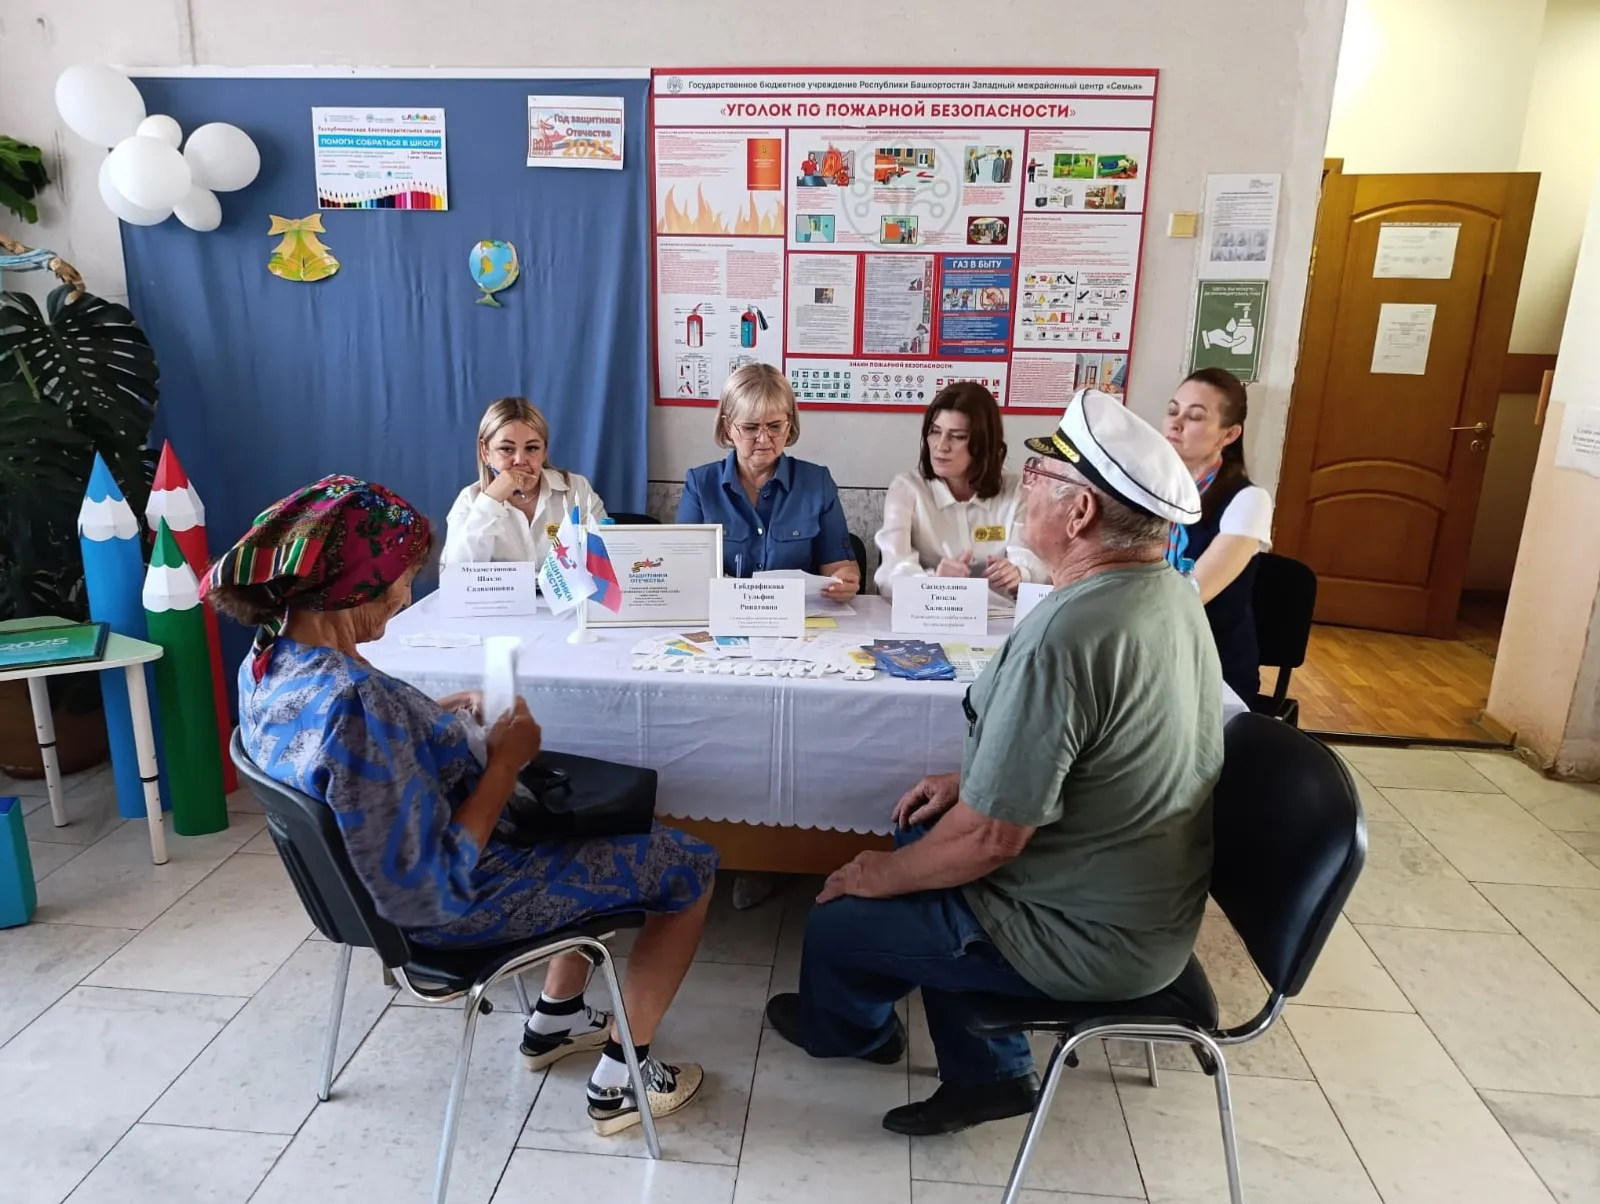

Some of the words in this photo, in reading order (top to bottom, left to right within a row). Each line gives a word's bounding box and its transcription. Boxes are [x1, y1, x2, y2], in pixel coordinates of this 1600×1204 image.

[688, 81, 758, 91] Государственное
[759, 80, 806, 91] бюджетное
[808, 81, 858, 91] учреждение
[859, 80, 909, 91] Республики
[910, 80, 970, 91] Башкортостан
[972, 81, 1015, 91] Западный
[1017, 81, 1077, 91] межрайонный
[1079, 82, 1104, 92] центр
[1106, 82, 1143, 92] «Семья»
[720, 103, 792, 117] «УГОЛОК
[797, 103, 821, 117] ПО
[825, 101, 926, 118] ПОЖАРНОЙ
[930, 103, 1076, 118] БЕЗОПАСНОСТИ»
[554, 114, 570, 125] Год
[571, 116, 621, 126] защитника
[566, 127, 612, 138] Отечества
[321, 138, 354, 146] ПОМОГИ
[355, 138, 401, 147] СОБРАТЬСЯ
[402, 139, 409, 147] В
[410, 139, 439, 148] ШКОЛУ
[562, 139, 615, 158] 2025
[952, 260, 969, 269] ГАЗ
[970, 260, 976, 269] В
[978, 260, 1002, 269] БЫТУ
[869, 361, 904, 369] ПОЖАРНОЙ
[544, 559, 563, 600] ТЕЧЕСТВА
